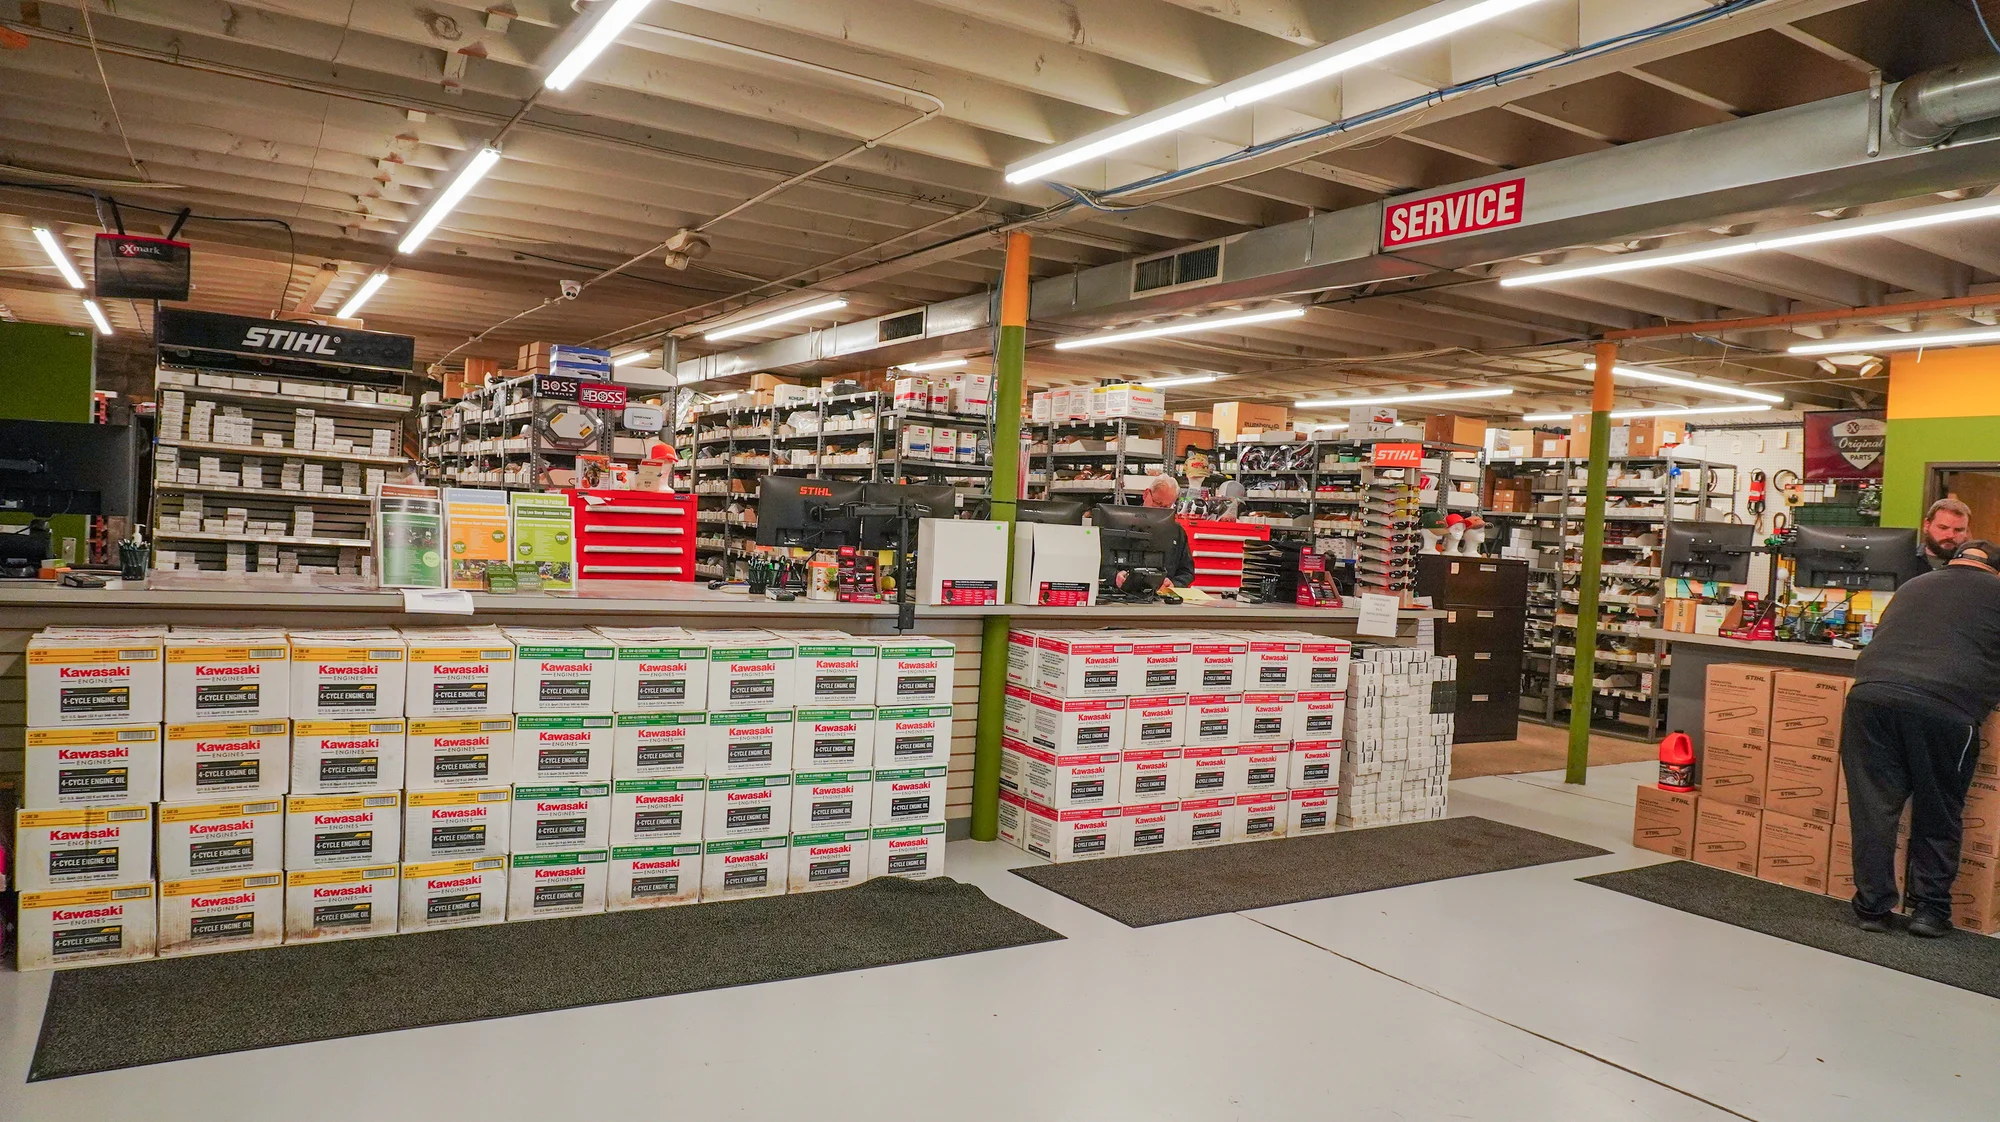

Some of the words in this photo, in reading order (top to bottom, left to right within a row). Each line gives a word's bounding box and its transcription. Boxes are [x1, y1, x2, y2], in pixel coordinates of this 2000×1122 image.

[1390, 184, 1517, 241] SERVICE
[541, 380, 577, 392] BOSS
[590, 391, 622, 404] BOSS
[1839, 437, 1884, 452] Original
[1376, 450, 1418, 460] STIHL
[800, 486, 832, 496] STIHL
[541, 663, 592, 671] Kawasaki
[639, 663, 687, 671] Kawasaki
[731, 663, 775, 672] Kawasaki
[816, 660, 858, 668] Kawasaki
[898, 661, 937, 669] Kawasaki
[60, 666, 130, 677] Kawasaki
[196, 665, 260, 675] Kawasaki
[319, 665, 378, 674] Kawasaki
[434, 665, 489, 674] Kawasaki
[1816, 683, 1838, 691] STIHL
[63, 697, 91, 705] 4-CYCLE
[198, 694, 224, 702] 4-CYCLE
[1078, 713, 1111, 721] Kawasaki
[1142, 709, 1173, 717] Kawasaki
[896, 721, 935, 730] Kawasaki
[638, 728, 686, 737] Kawasaki
[729, 726, 773, 736] Kawasaki
[540, 732, 591, 740] Kawasaki
[321, 739, 379, 749] Kawasaki
[434, 736, 489, 746] Kawasaki
[197, 740, 260, 752] Kawasaki
[1743, 743, 1762, 751] STIHL
[59, 747, 129, 759] Kawasaki
[1812, 755, 1833, 763] STIHL
[1072, 766, 1105, 775] Kawasaki
[1137, 762, 1167, 770] Kawasaki
[198, 770, 224, 778] 4-CYCLE
[61, 778, 89, 786] 4-CYCLE
[91, 777, 114, 785] ENGINE
[892, 781, 931, 791] Kawasaki
[813, 786, 854, 795] Kawasaki
[1971, 782, 1997, 791] STIHL
[636, 794, 683, 803] Kawasaki
[728, 790, 772, 801] Kawasaki
[1671, 797, 1689, 805] STIHL
[537, 801, 588, 811] Kawasaki
[1248, 805, 1275, 813] Kawasaki
[432, 807, 487, 818] Kawasaki
[1193, 810, 1222, 818] Kawasaki
[1736, 810, 1756, 818] STIHL
[315, 812, 373, 824] Kawasaki
[1135, 815, 1166, 824] Kawasaki
[190, 820, 254, 834] Kawasaki
[1074, 821, 1107, 830] Kawasaki
[1803, 823, 1824, 831] STIHL
[50, 827, 120, 840] Kawasaki
[889, 838, 928, 848] Kawasaki
[192, 851, 218, 859] 4-CYCLE
[219, 848, 240, 856] ENGINE
[810, 845, 851, 855] Kawasaki
[52, 859, 80, 867] 4-CYCLE
[82, 857, 104, 865] ENGINE
[725, 852, 768, 863] Kawasaki
[633, 859, 680, 870] Kawasaki
[535, 867, 586, 878] Kawasaki
[428, 875, 482, 889] Kawasaki
[314, 884, 372, 897] Kawasaki
[191, 893, 255, 908] Kawasaki
[53, 905, 123, 920] Kawasaki
